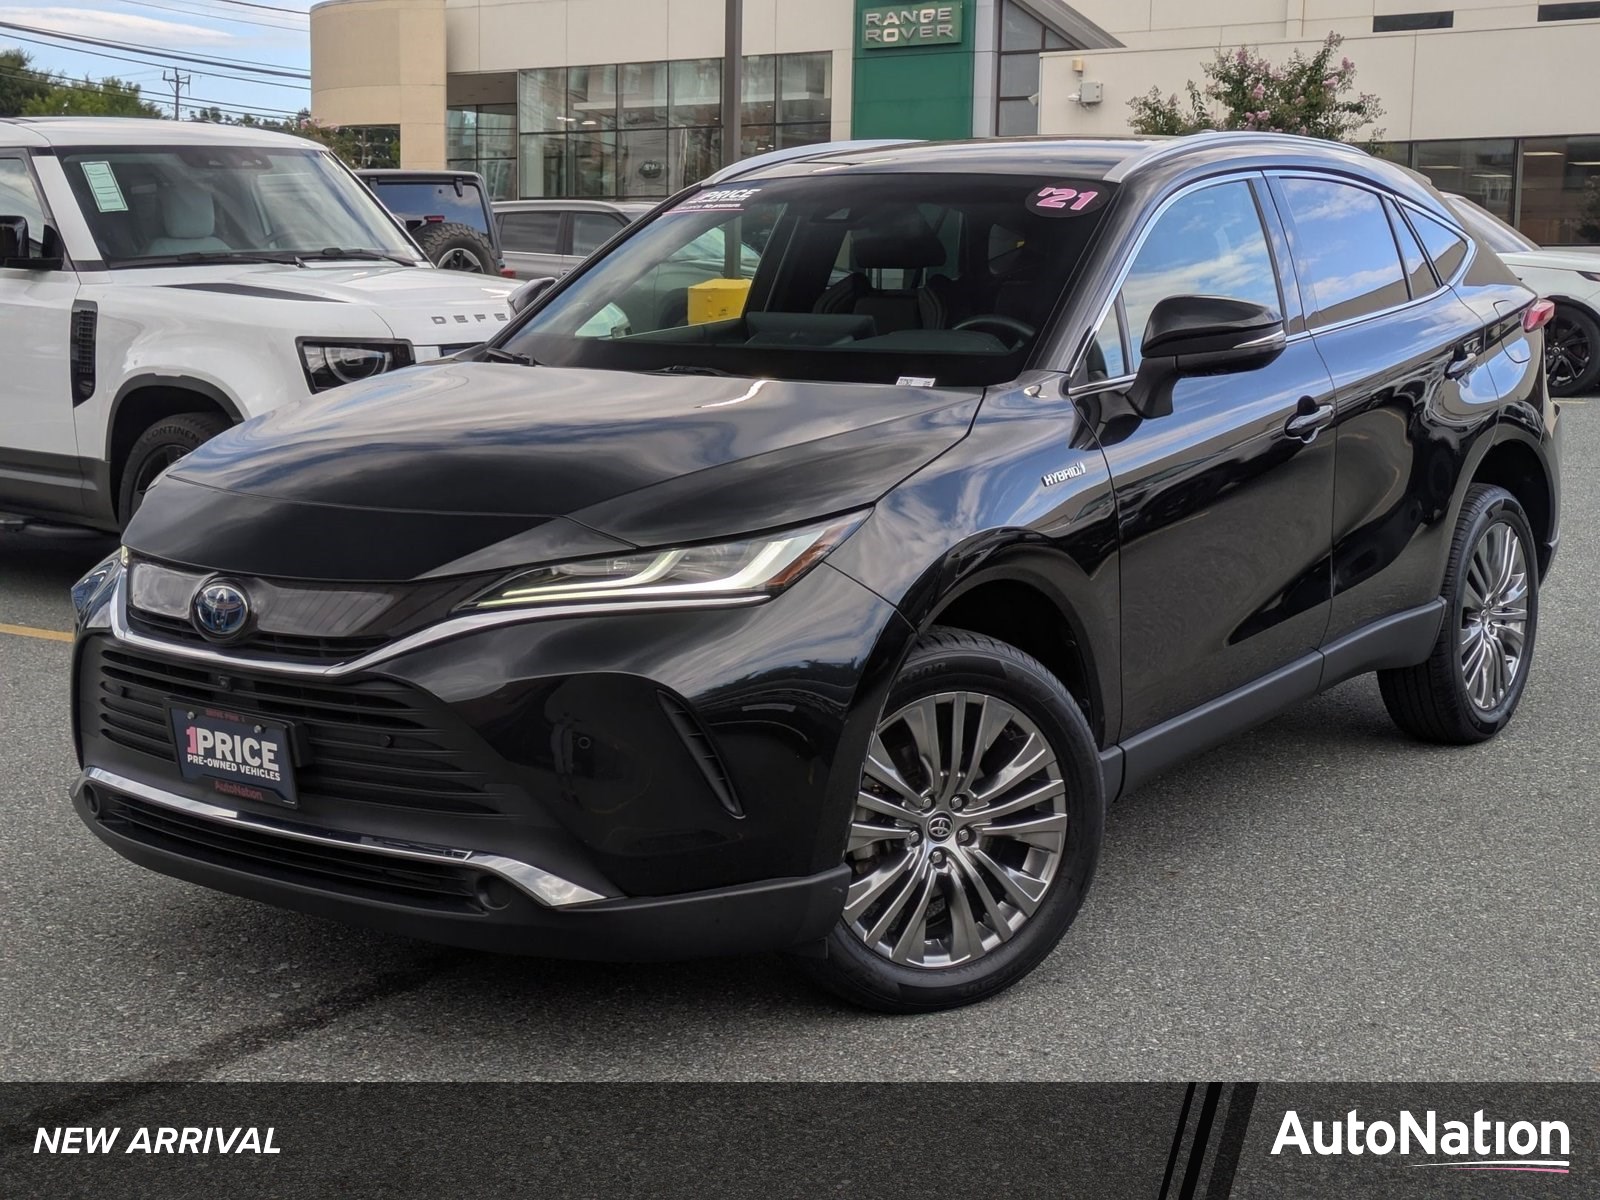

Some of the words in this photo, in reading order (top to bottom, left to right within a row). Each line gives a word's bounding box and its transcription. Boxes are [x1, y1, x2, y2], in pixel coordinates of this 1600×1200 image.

[865, 7, 953, 26] RANGE
[865, 24, 953, 42] ROVER
[1042, 464, 1082, 487] HYBRID
[187, 754, 238, 772] PRE-OWNED
[239, 764, 281, 782] VEHICLES
[214, 780, 264, 800] AutoNation
